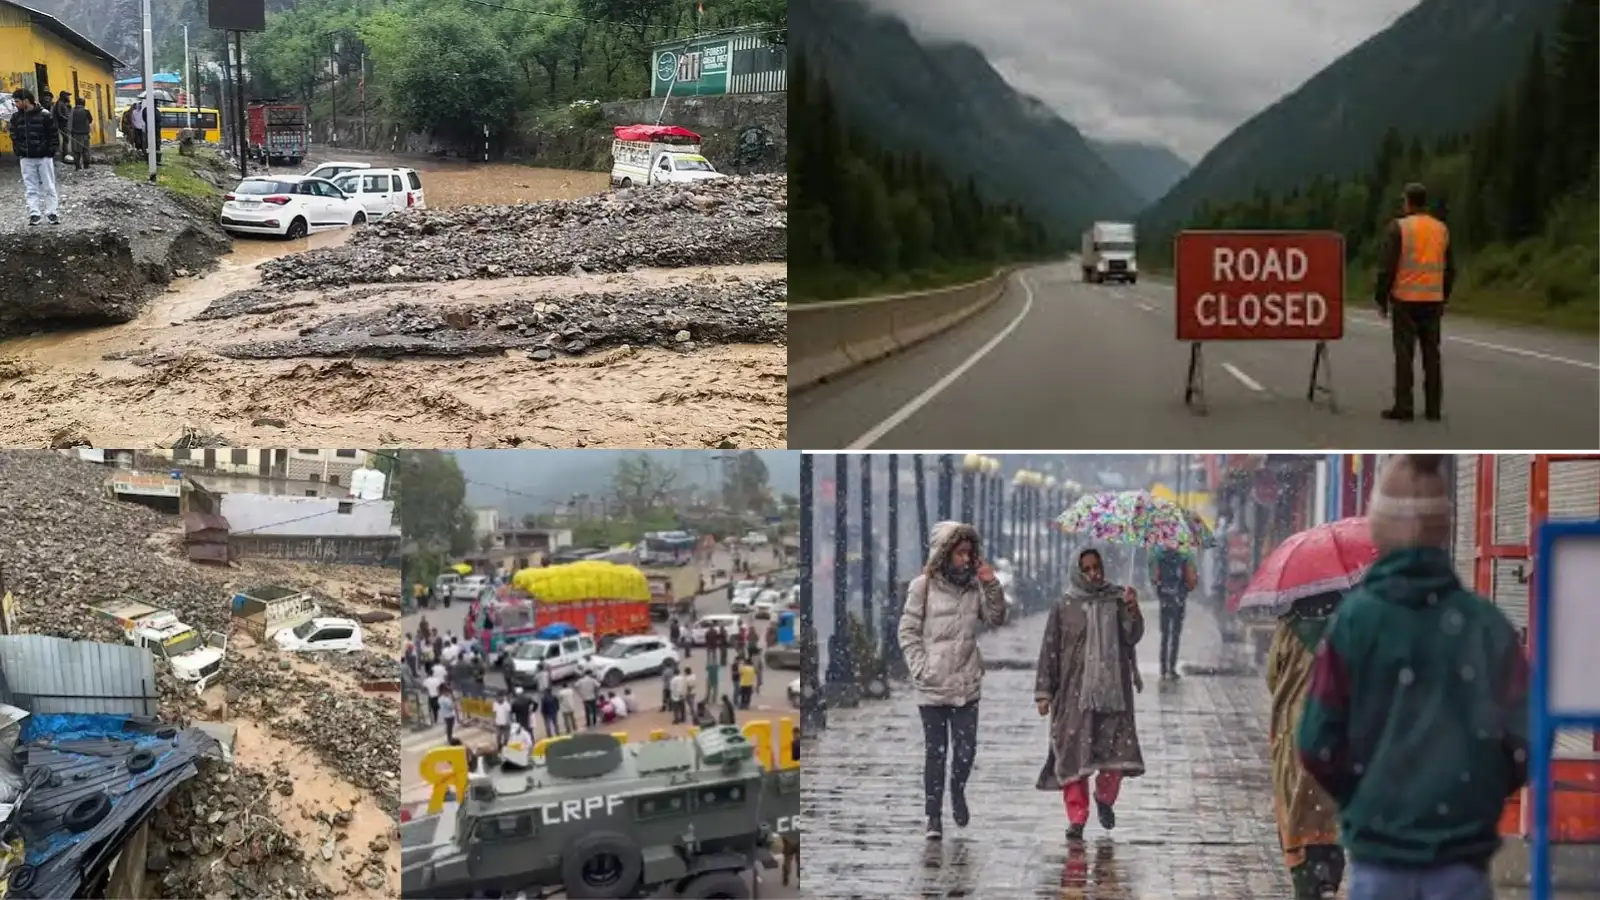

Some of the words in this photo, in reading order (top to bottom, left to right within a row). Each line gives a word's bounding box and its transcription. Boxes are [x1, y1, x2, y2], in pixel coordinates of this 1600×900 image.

[1213, 247, 1308, 281] ROAD
[1195, 292, 1327, 326] CLOSED
[541, 794, 624, 825] CRPF
